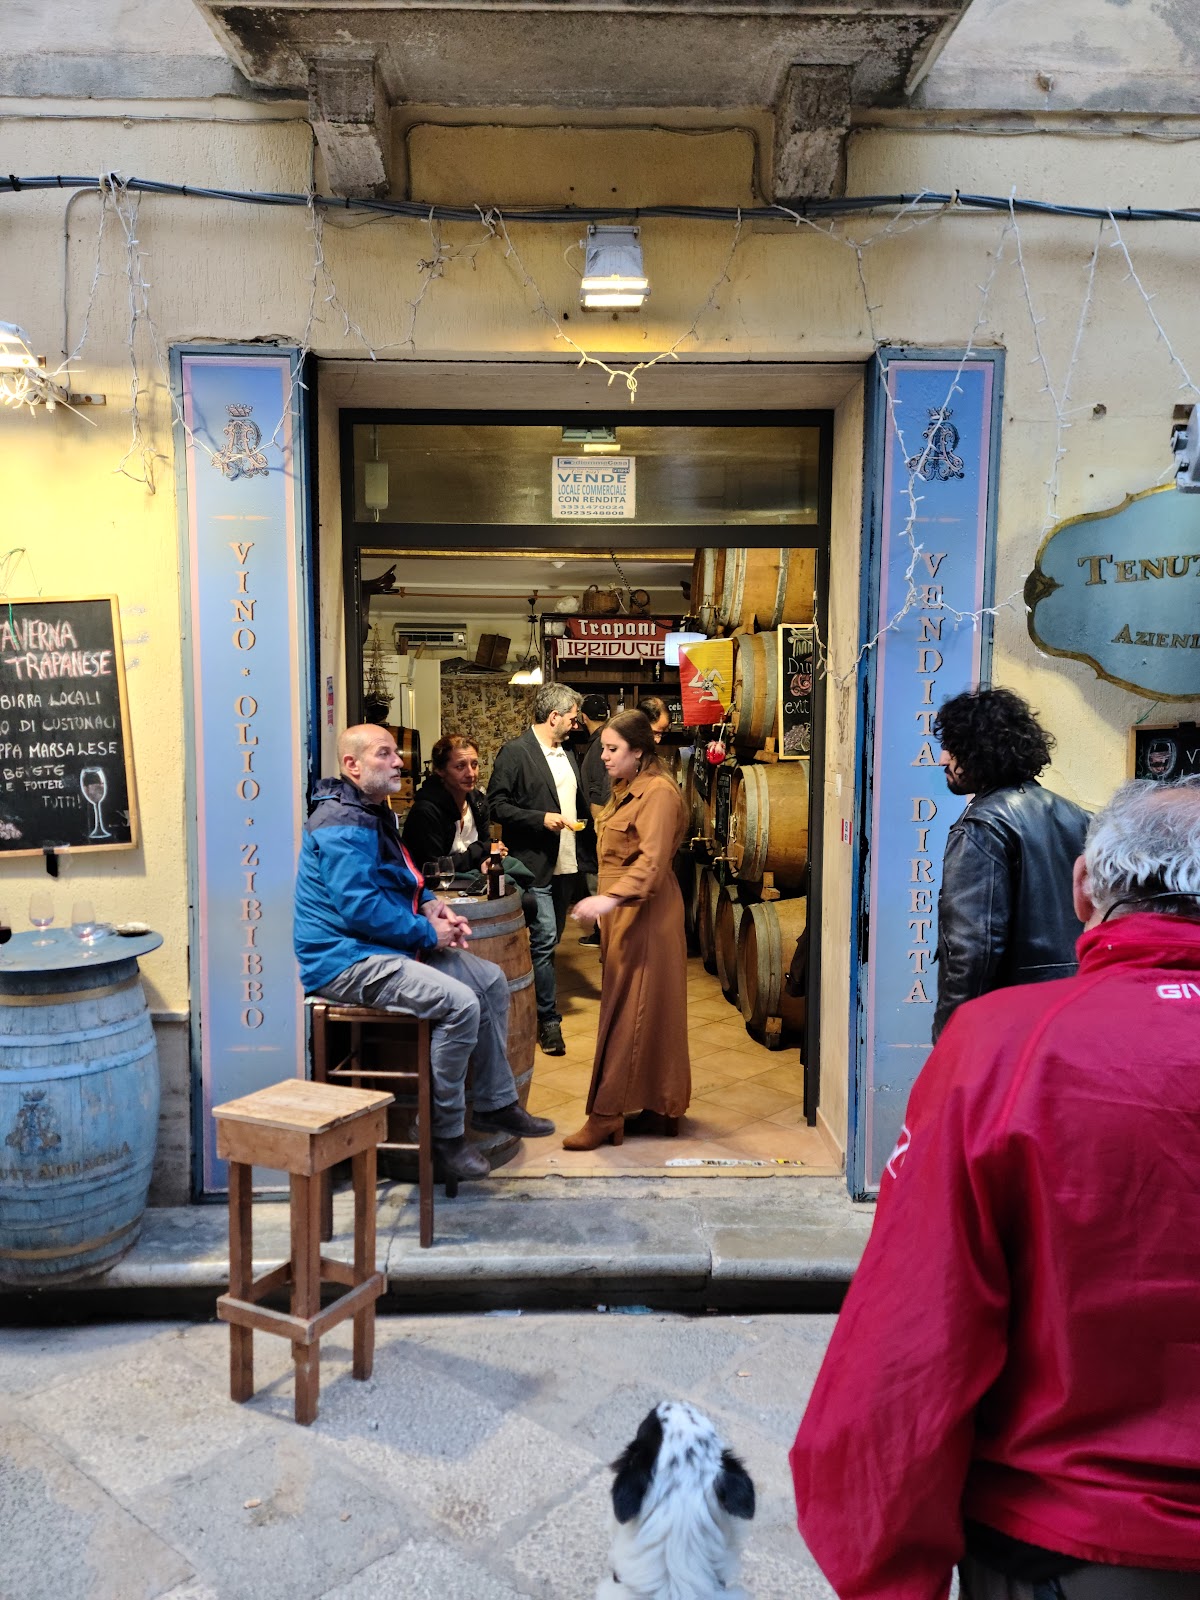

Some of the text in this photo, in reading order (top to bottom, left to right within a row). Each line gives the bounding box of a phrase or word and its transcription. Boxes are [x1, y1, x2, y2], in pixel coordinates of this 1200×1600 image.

[557, 474, 627, 483] VENDE
[558, 485, 627, 496] LOCALE COMMERCIALE
[0, 618, 78, 652] AVERNA
[578, 620, 656, 638] Trapani
[4, 650, 113, 680] TRAPANESE
[0, 690, 101, 710] BIRRA LOCALI
[19, 720, 36, 732] DI
[29, 741, 118, 758] MARSALESE
[228, 541, 265, 1029] VINO OLIO ZIBIBBO
[903, 552, 948, 1004] VENDITA DIRETTA
